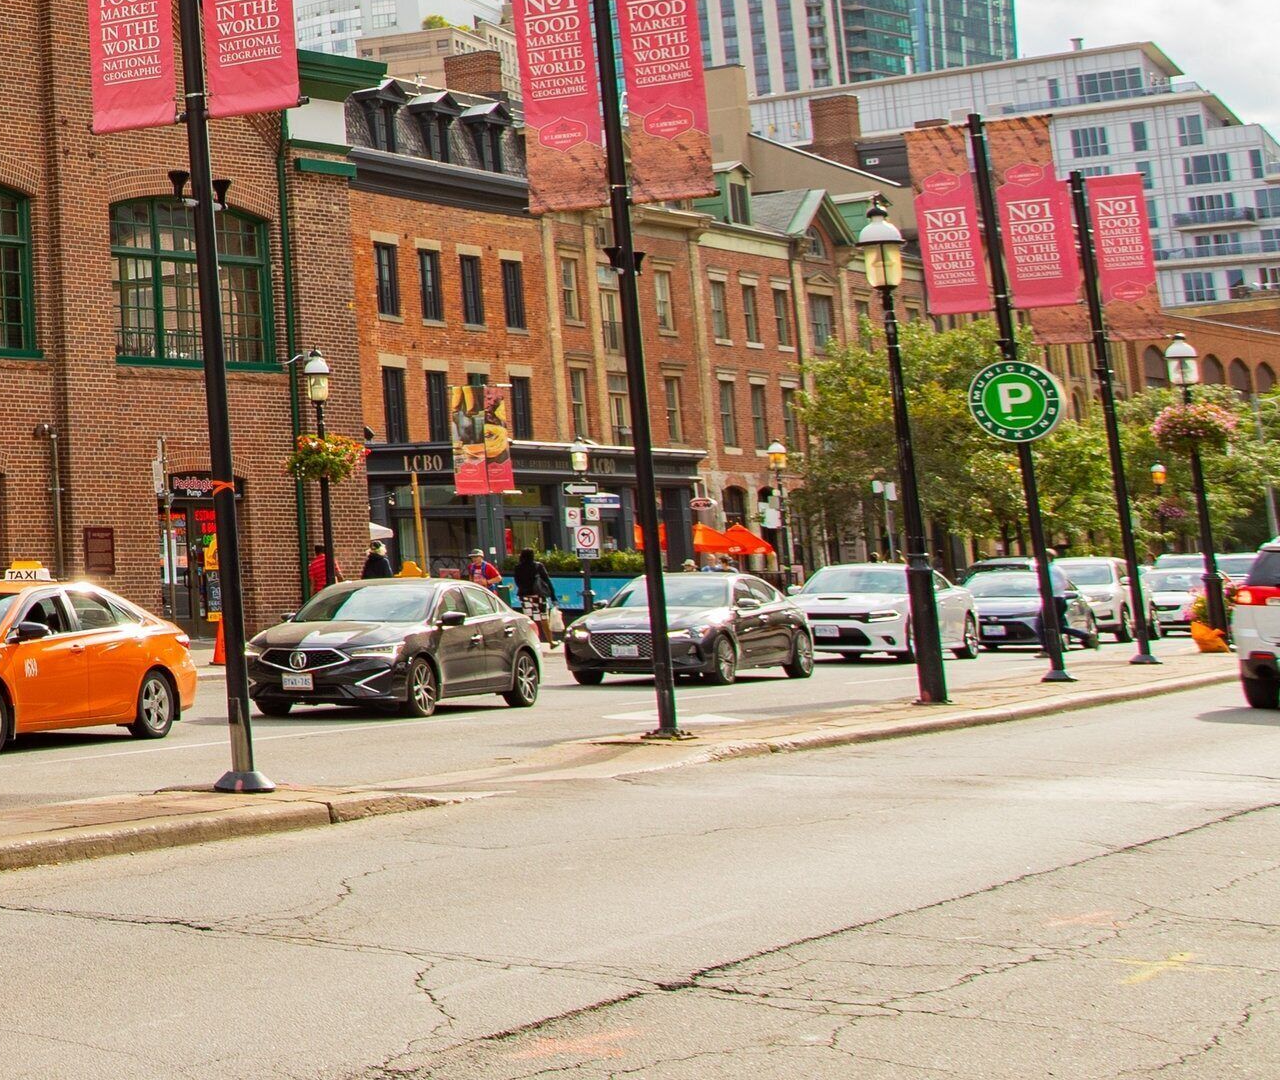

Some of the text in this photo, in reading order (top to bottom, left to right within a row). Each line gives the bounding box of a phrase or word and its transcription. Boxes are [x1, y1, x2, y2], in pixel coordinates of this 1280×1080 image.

[101, 1, 158, 21] MARKET
[216, 5, 235, 21] IN
[627, 0, 686, 22] FOOD
[101, 20, 159, 41] IN THE
[217, 15, 279, 36] WORLD
[525, 15, 580, 37] FOOD
[629, 15, 687, 33] MARKET
[102, 35, 160, 55] WORLD
[219, 34, 281, 53] NATIONAL
[526, 30, 580, 48] MARKET
[632, 30, 689, 51] IN THE
[220, 46, 281, 63] GEOGRAPHIC
[528, 46, 583, 65] IN THE
[633, 44, 690, 62] WORLD
[102, 55, 161, 71] NATIONAL
[529, 59, 586, 77] WORLD
[635, 60, 691, 76] NATIONAL
[103, 66, 161, 81] GEOGRAPHIC
[636, 70, 693, 85] GEOGRAPHIC
[531, 75, 587, 90] NATIONAL
[532, 84, 588, 99] GEOGRAPHIC
[1010, 222, 1055, 235] FOOD
[1098, 217, 1140, 229] FOOD
[927, 230, 970, 243] FOOD
[1011, 232, 1055, 243] MARKET
[1100, 227, 1140, 236] MARKET
[928, 240, 971, 251] MARKET
[1013, 243, 1058, 255] IN THE
[1101, 236, 1143, 247] IN THE
[1102, 245, 1144, 254] WORLD
[930, 251, 973, 263] IN THE
[932, 260, 975, 270] WORLD
[1014, 253, 1060, 263] WORLD
[973, 365, 1054, 400] MUNICIPAL
[997, 382, 1032, 413] P
[976, 407, 1056, 438] PARKING
[403, 455, 443, 472] LCBO
[592, 458, 615, 474] LCBO
[186, 489, 202, 497] Pump
[8, 571, 37, 580] TAXI
